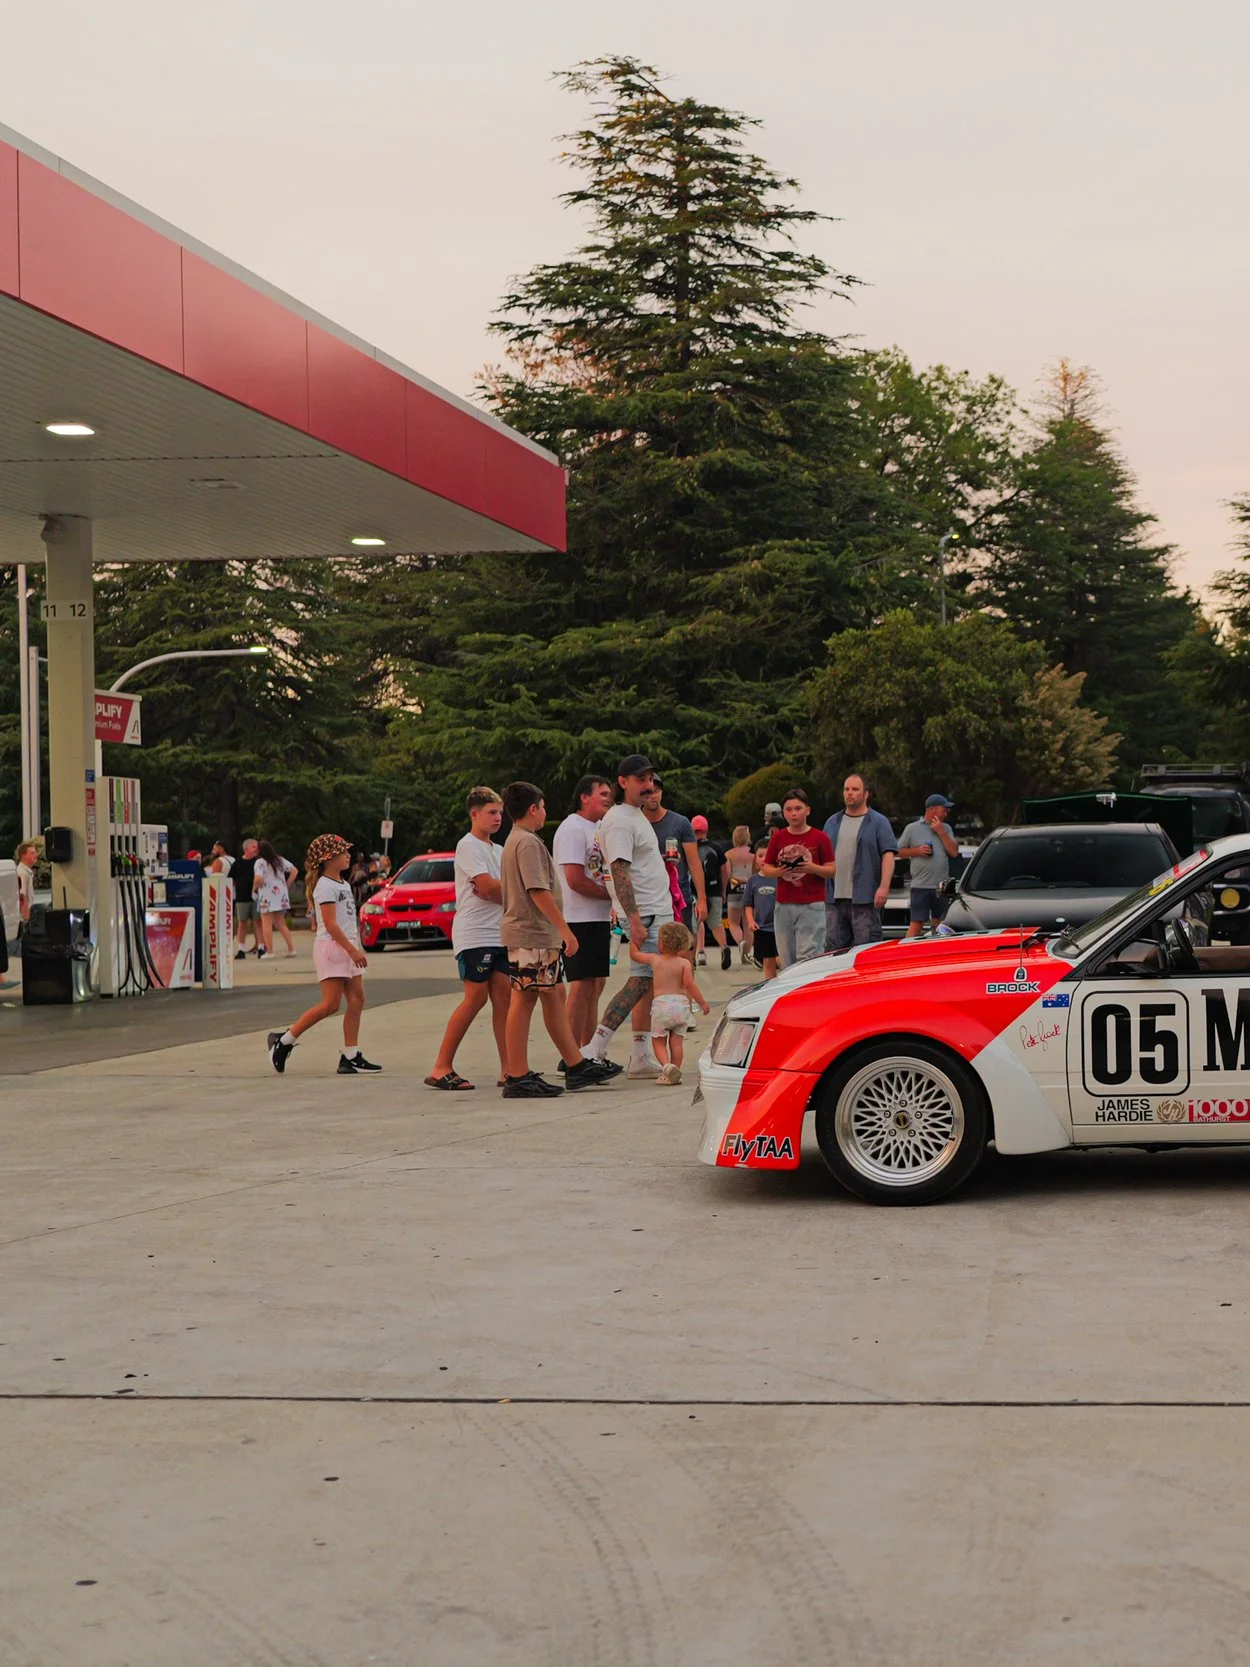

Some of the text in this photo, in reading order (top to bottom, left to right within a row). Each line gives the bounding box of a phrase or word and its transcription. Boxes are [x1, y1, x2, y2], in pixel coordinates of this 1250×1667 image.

[43, 603, 86, 617] 11 12
[208, 899, 217, 983] AMPLIFY
[987, 982, 1039, 993] BROCK
[1091, 1003, 1179, 1085] 05
[1097, 1099, 1150, 1111] JAMES
[1188, 1099, 1249, 1117] 1000
[1095, 1110, 1153, 1122] HARDIE
[722, 1132, 795, 1163] FlyTAA
